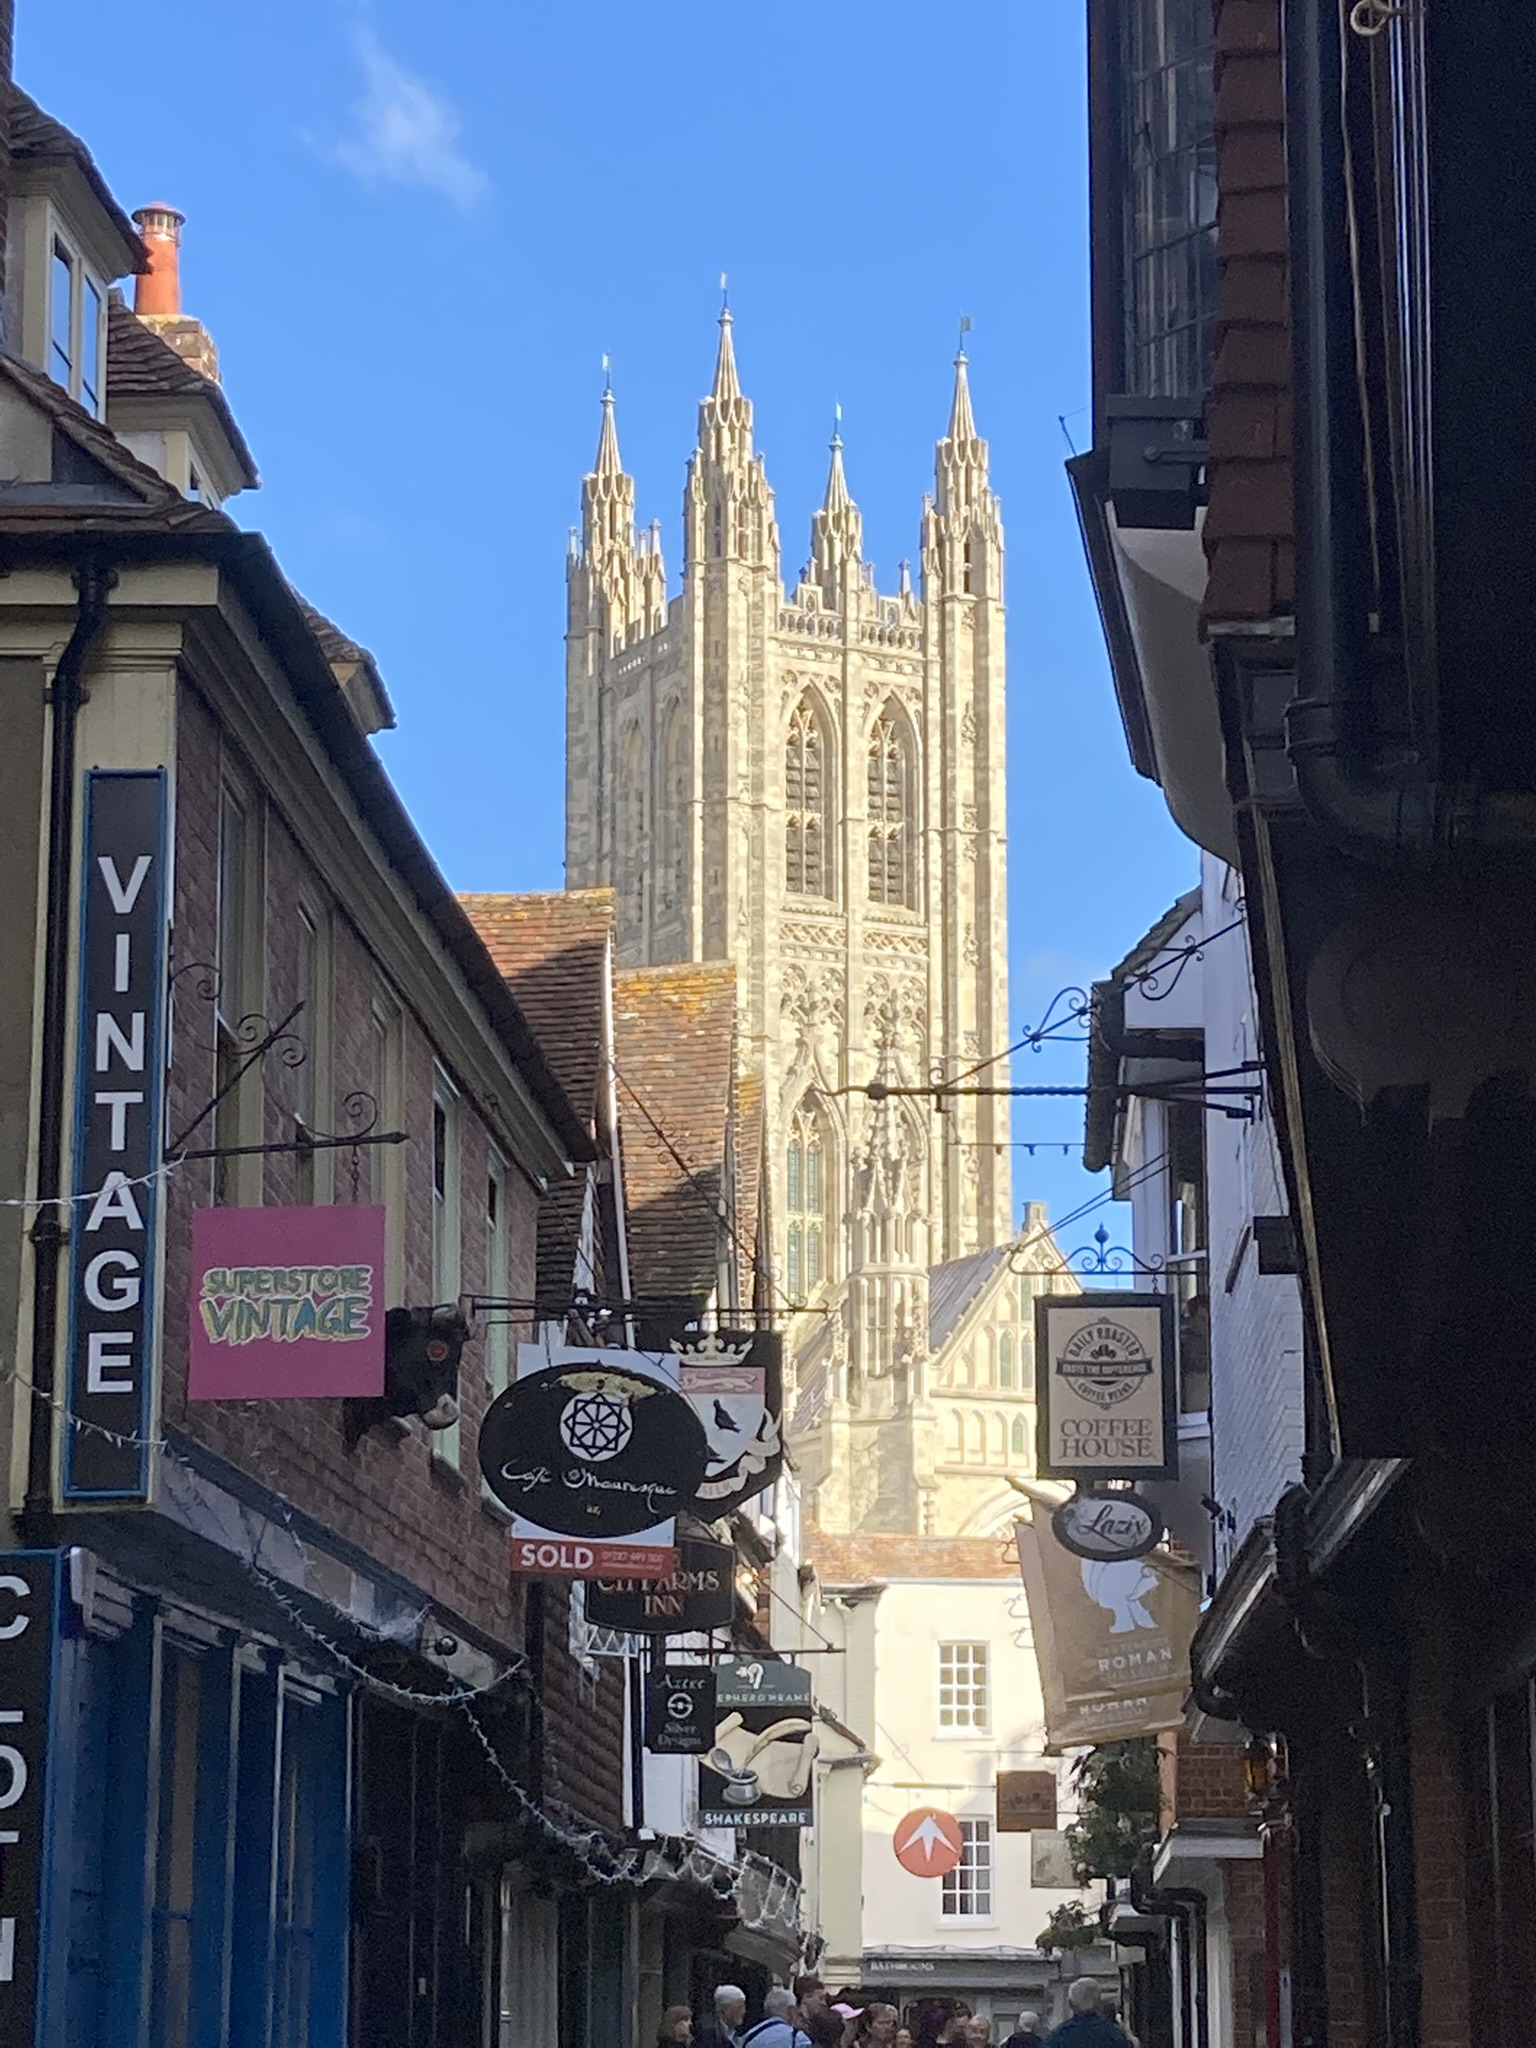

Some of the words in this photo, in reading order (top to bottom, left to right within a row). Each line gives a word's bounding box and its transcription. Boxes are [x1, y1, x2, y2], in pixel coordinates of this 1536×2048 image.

[83, 856, 153, 1394] VINTAGE
[201, 1265, 373, 1298] SUPERSTORE
[200, 1296, 373, 1346] VINTAGE
[1067, 1330, 1095, 1358] DAILY
[1096, 1327, 1140, 1357] ROASTED
[1060, 1418, 1152, 1438] COFFEE
[1060, 1438, 1152, 1459] HOUSE
[520, 1543, 595, 1570] SOLD
[655, 1570, 720, 1592] ARMS
[644, 1594, 685, 1617] INN
[1097, 1646, 1173, 1673] ROMAN
[704, 1812, 806, 1825] SHAKESPEARE
